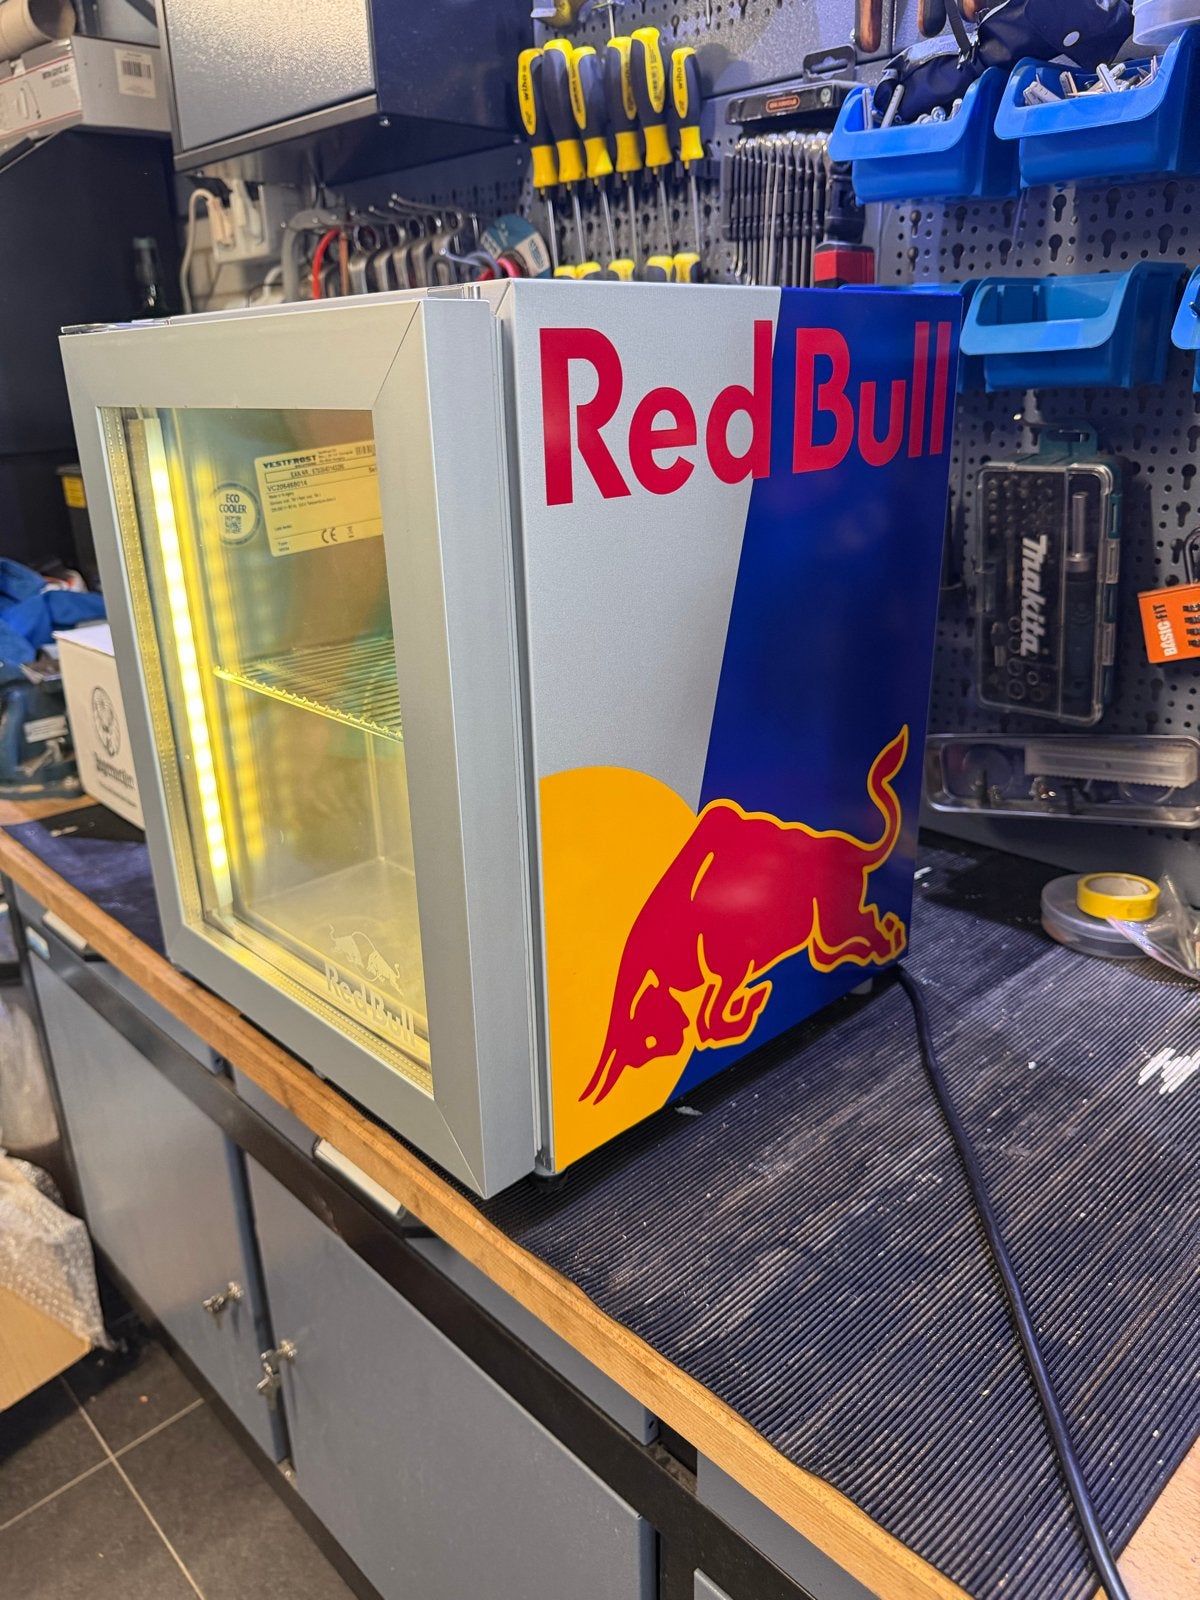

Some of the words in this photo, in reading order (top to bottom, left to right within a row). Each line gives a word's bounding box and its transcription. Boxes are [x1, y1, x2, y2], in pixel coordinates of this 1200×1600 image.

[539, 320, 773, 506] Red
[793, 321, 952, 475] Bull
[262, 455, 317, 469] VESTFROST
[225, 493, 240, 503] ECO
[218, 504, 247, 513] COOLER
